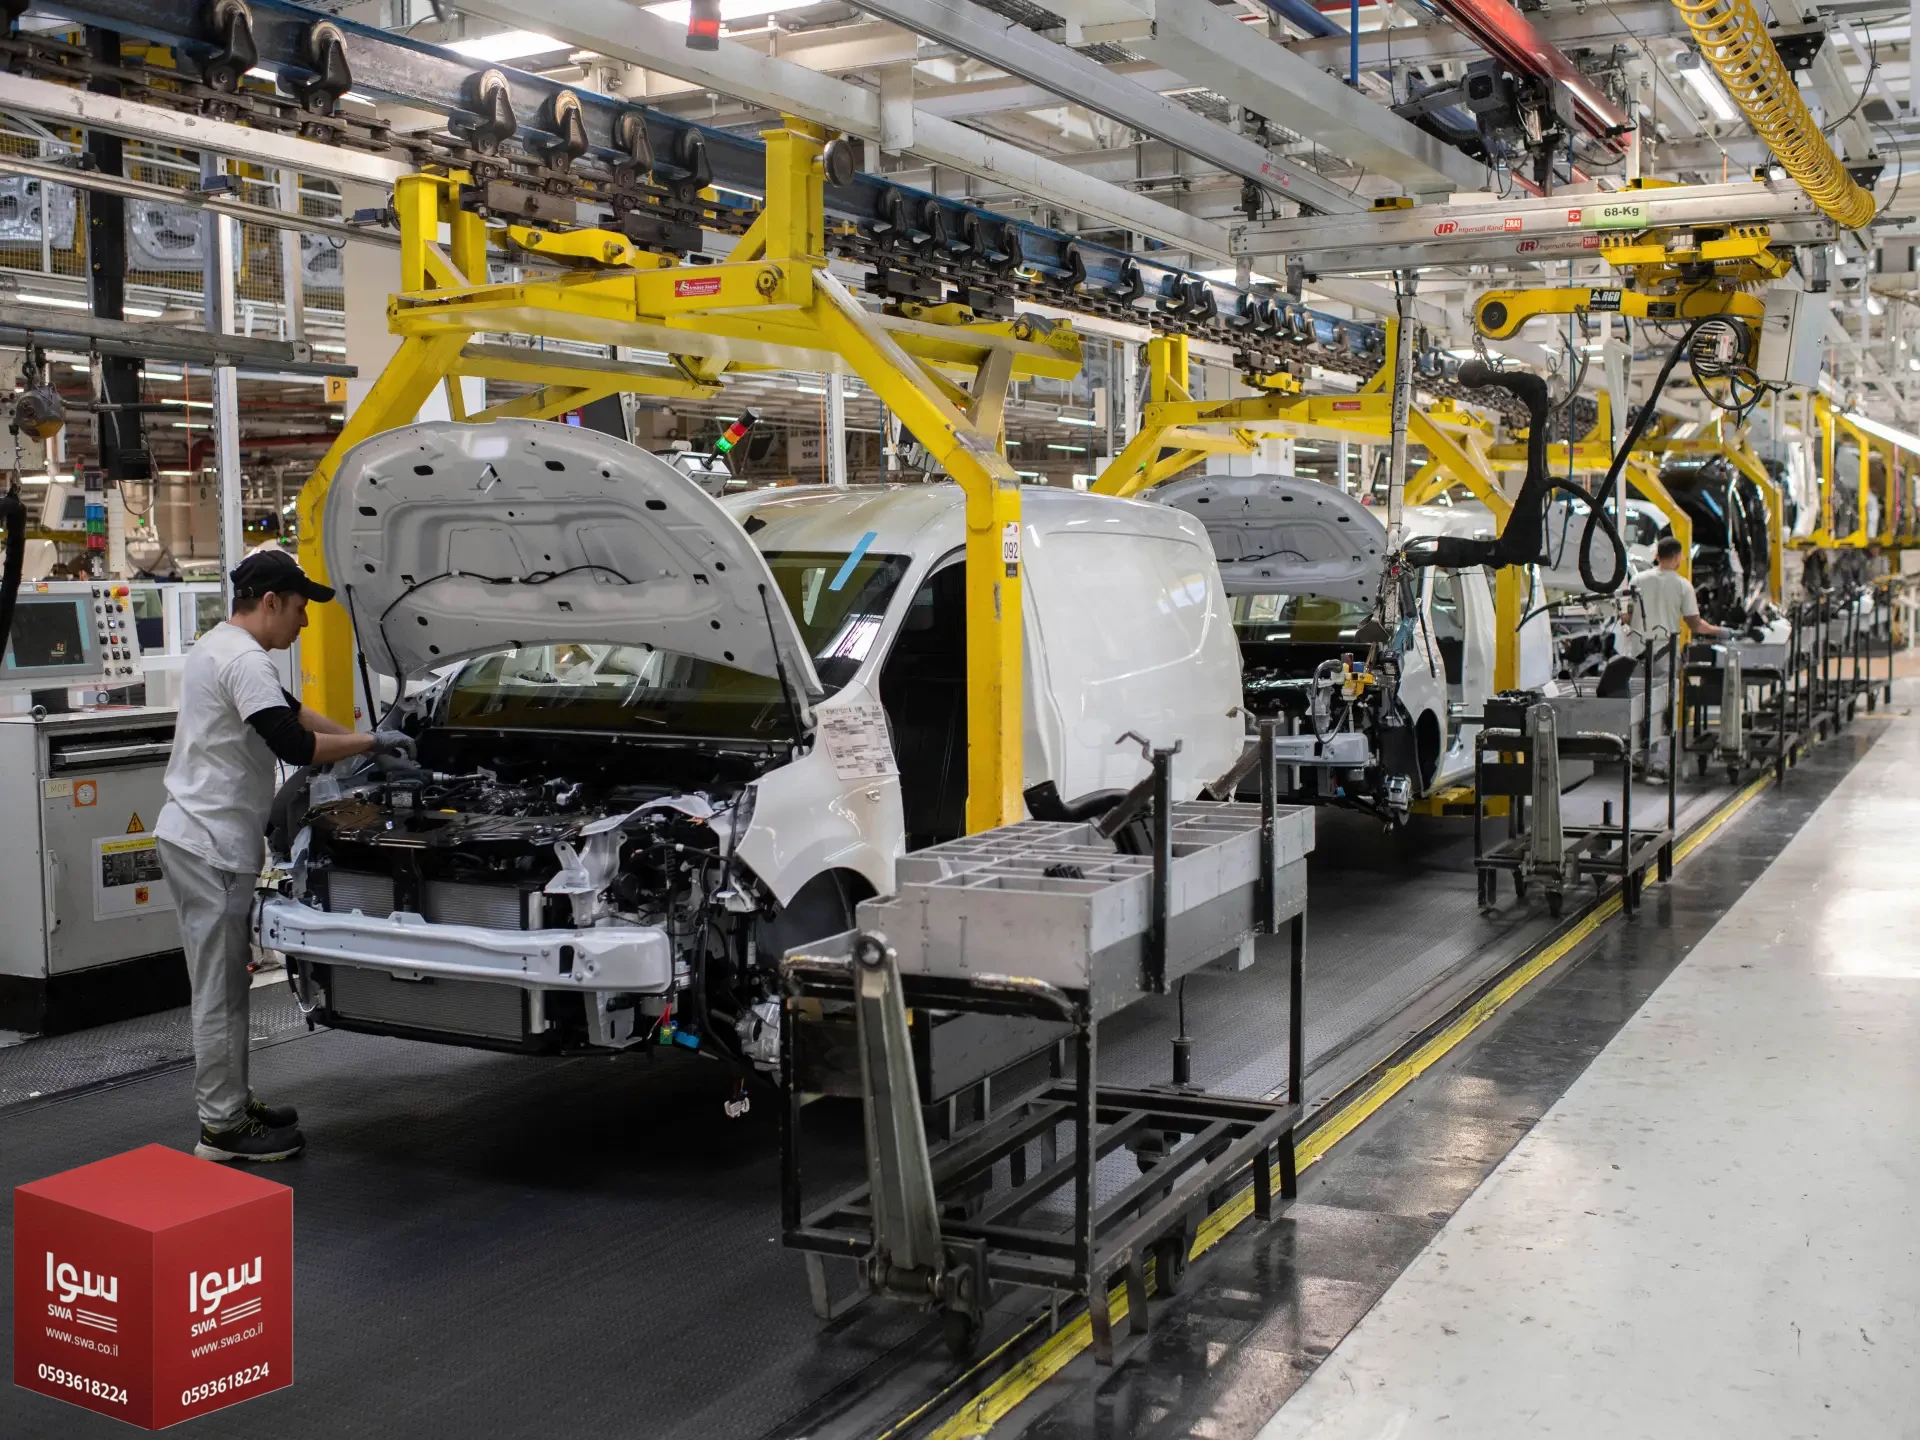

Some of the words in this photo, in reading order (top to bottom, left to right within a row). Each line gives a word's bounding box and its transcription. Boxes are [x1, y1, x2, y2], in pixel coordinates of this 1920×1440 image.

[1604, 206, 1640, 217] 68-Kg
[1458, 225, 1485, 233] Ingersoll
[1486, 223, 1503, 232] Rand
[332, 380, 341, 394] P
[802, 439, 819, 448] UET
[1004, 541, 1019, 559] 092
